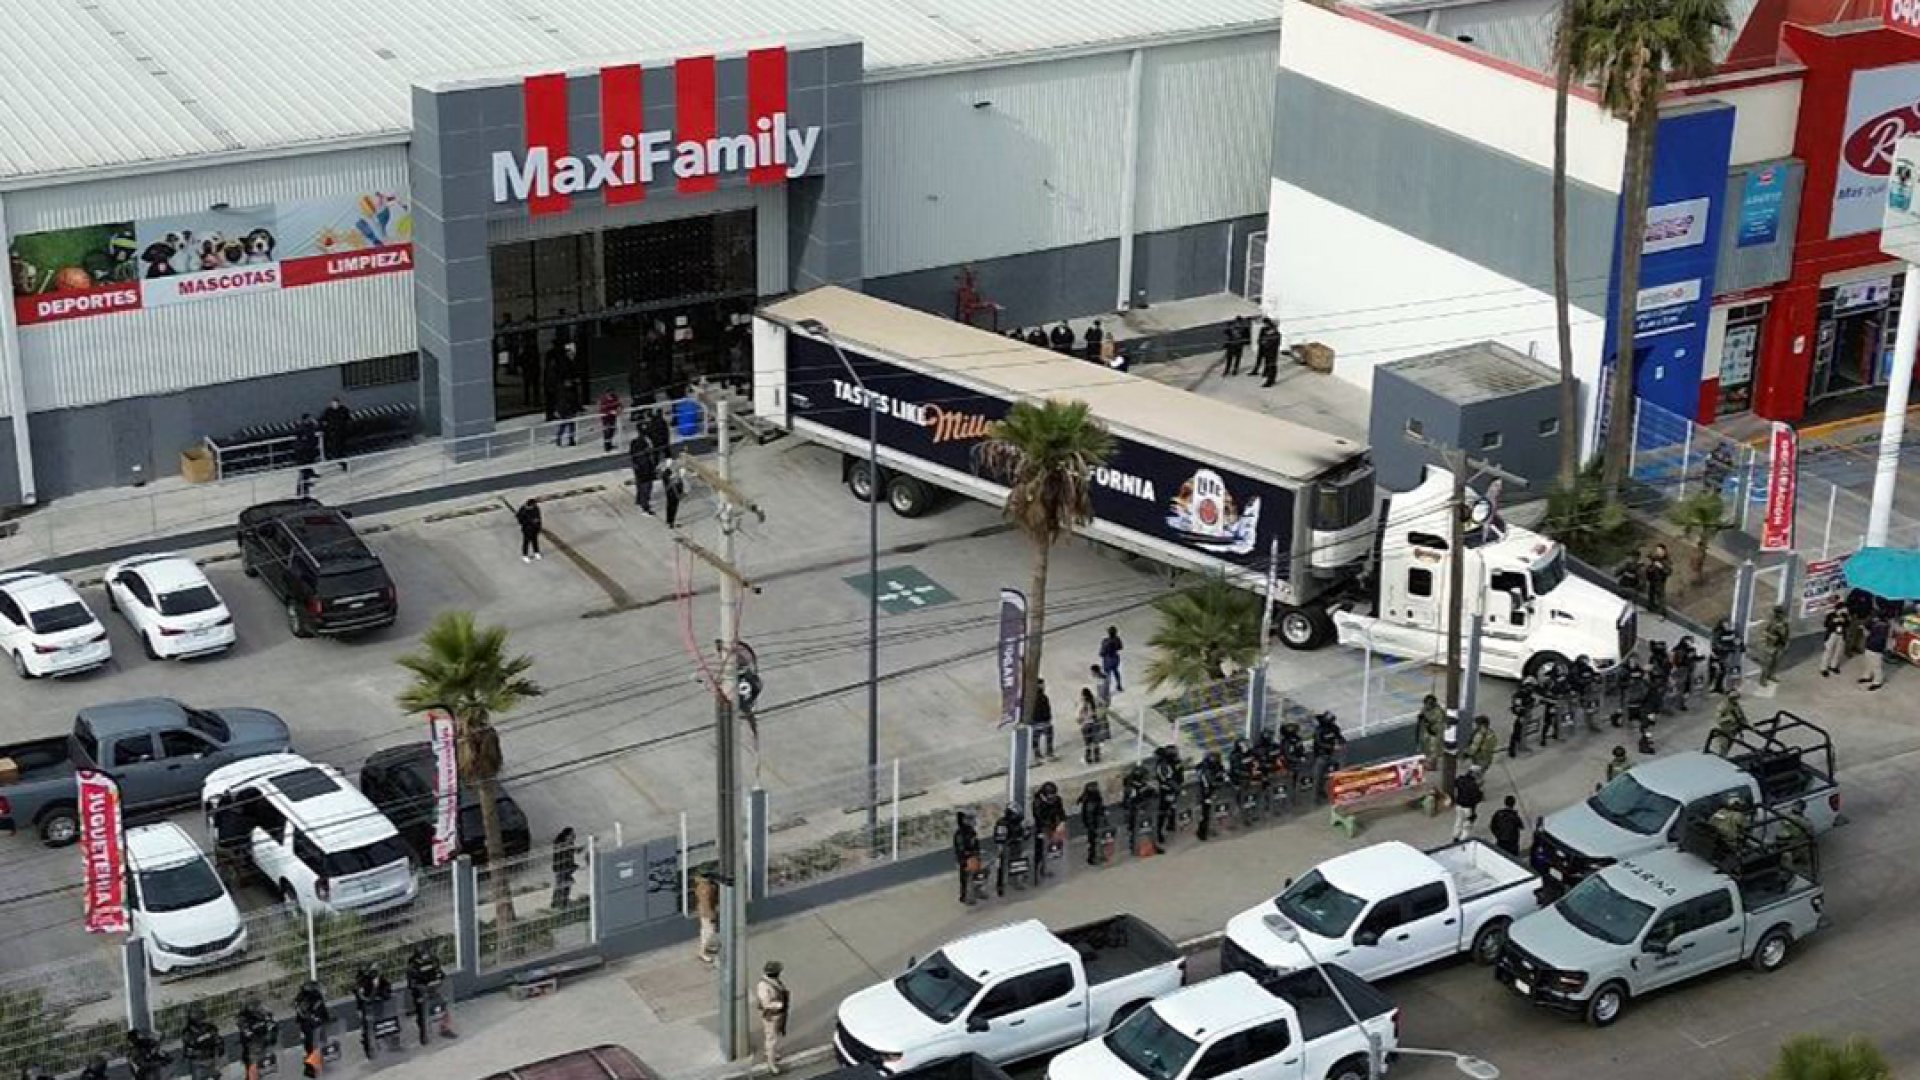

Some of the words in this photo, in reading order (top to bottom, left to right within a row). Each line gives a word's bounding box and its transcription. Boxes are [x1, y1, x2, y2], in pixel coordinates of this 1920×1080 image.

[491, 112, 821, 202] MaxiFamily
[327, 249, 412, 274] LIMPIEZA
[178, 269, 277, 295] MASCOTAS
[38, 289, 138, 316] DEPORTES
[891, 397, 928, 427] LIKE
[88, 792, 112, 905] JUGUETERIA
